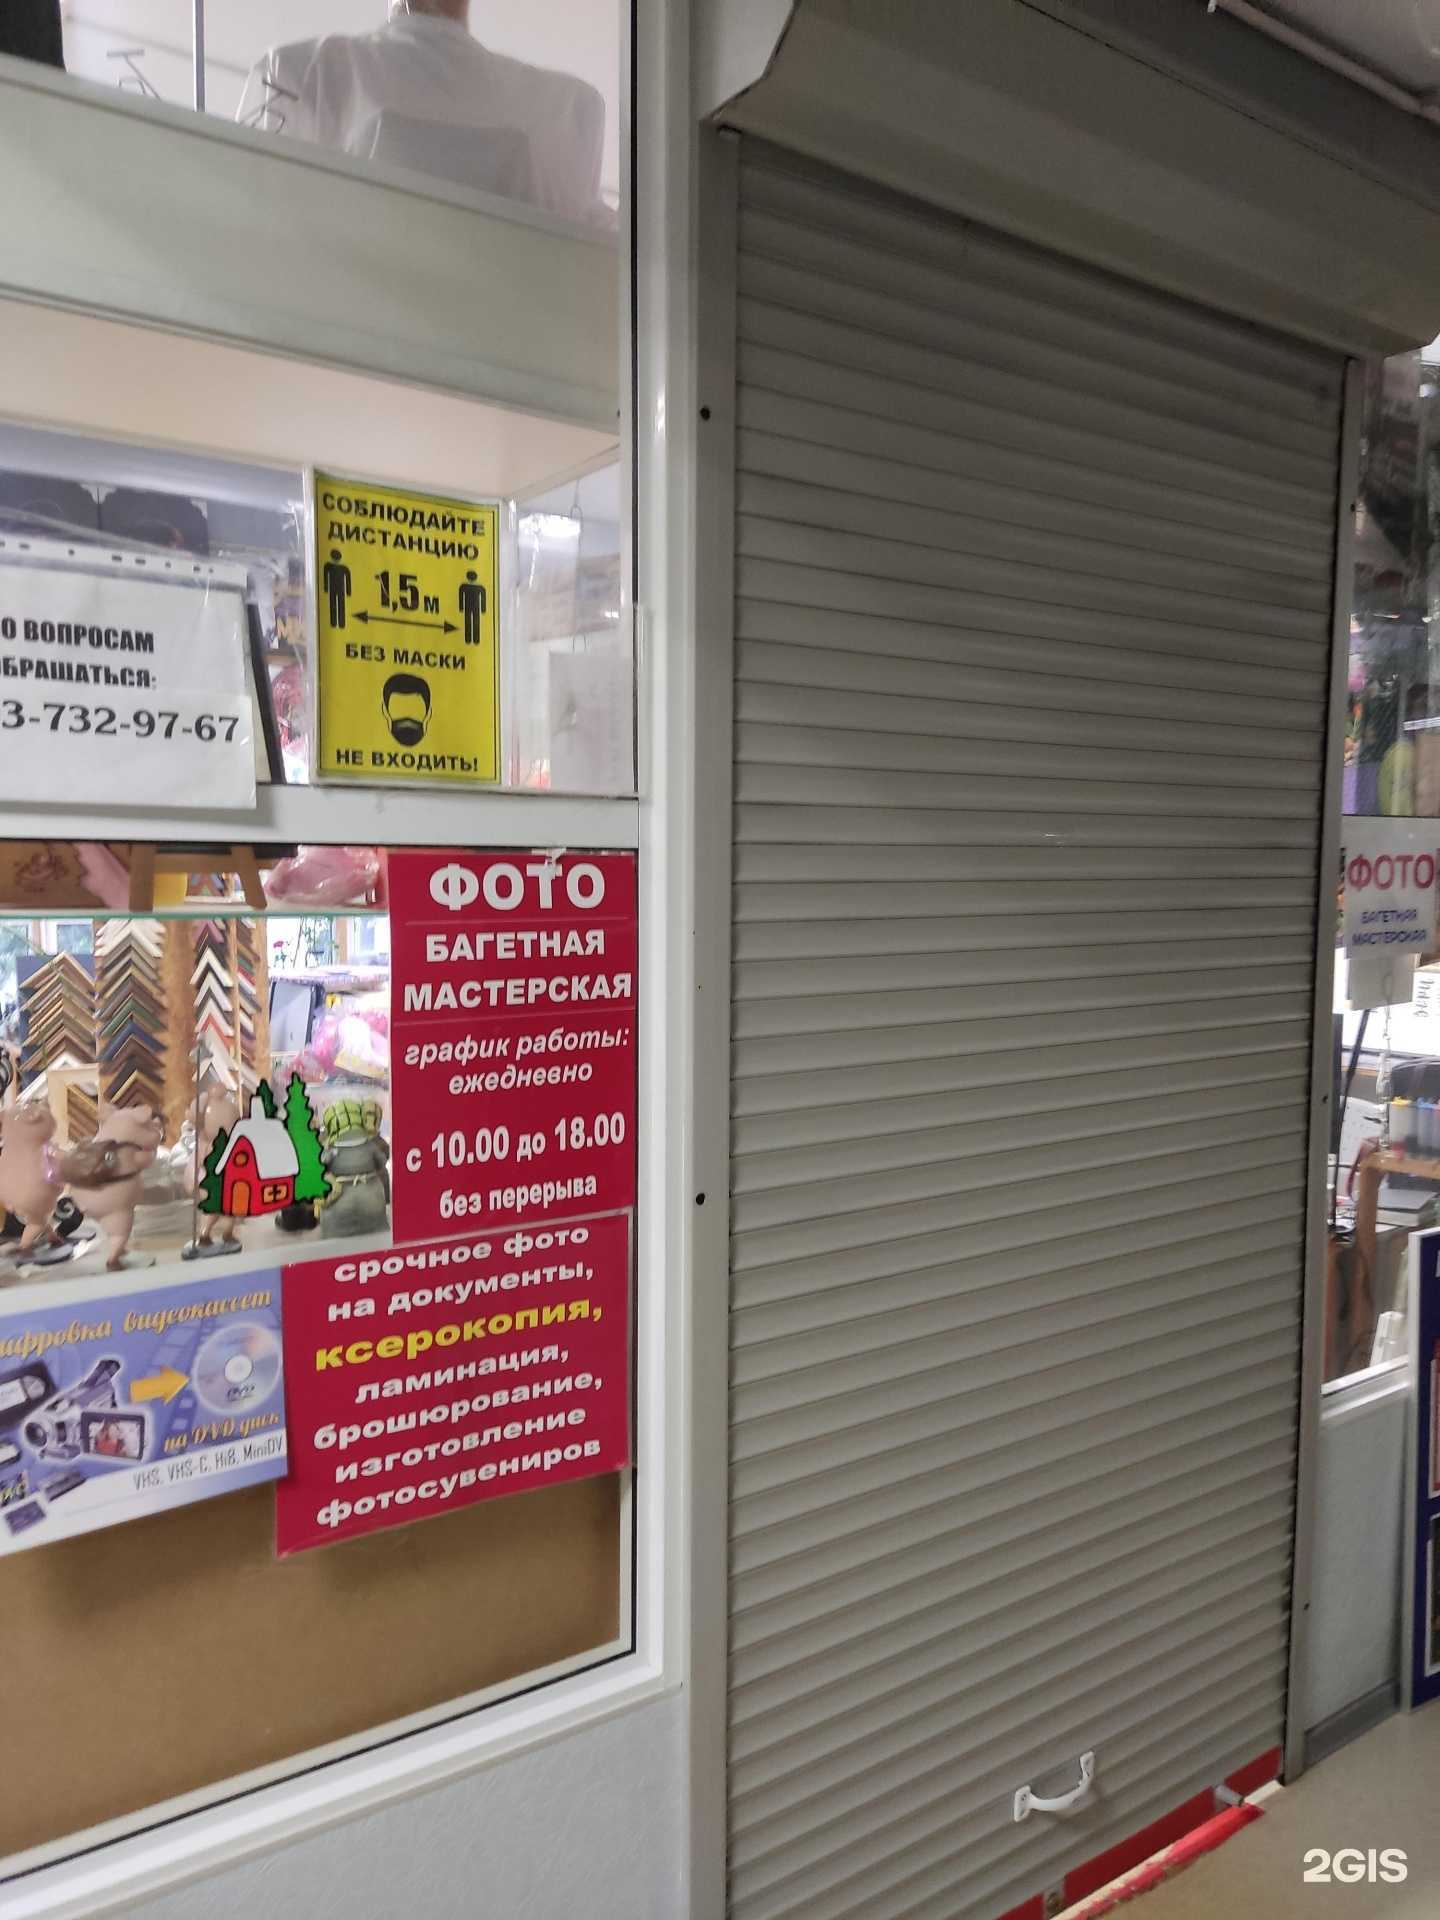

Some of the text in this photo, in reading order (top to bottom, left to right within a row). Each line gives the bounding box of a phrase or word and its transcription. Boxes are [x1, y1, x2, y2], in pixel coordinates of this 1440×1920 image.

[322, 491, 486, 537] СОБЛЮДАЙТЕ
[327, 520, 480, 561] ДИСТАНЦИЮ
[375, 570, 420, 613] 1,5
[23, 618, 155, 654] ВОПРОСАМ
[345, 643, 466, 671] БЕЗ МАСКИ
[336, 748, 478, 772] НЕ ВХОДИТЬ!
[429, 863, 605, 911] ФОТО
[1347, 853, 1435, 892] ФОТО
[426, 928, 605, 963] БАГЕТНАЯ
[403, 972, 632, 1012] МАСТЕРСКАЯ
[404, 1026, 631, 1070] график работы:
[449, 1062, 593, 1096] ежедневно
[406, 1111, 625, 1172] с 10.00 до 18.00
[440, 1173, 597, 1219] без перерыва
[334, 1226, 589, 1284] срочное фото
[327, 1262, 594, 1322] на документы,
[315, 1298, 603, 1372] ксерокопия,
[354, 1343, 570, 1404] ламинация,
[313, 1372, 602, 1450] брошюрование,
[334, 1408, 587, 1483] изготовление
[316, 1438, 601, 1528] фотосувениров
